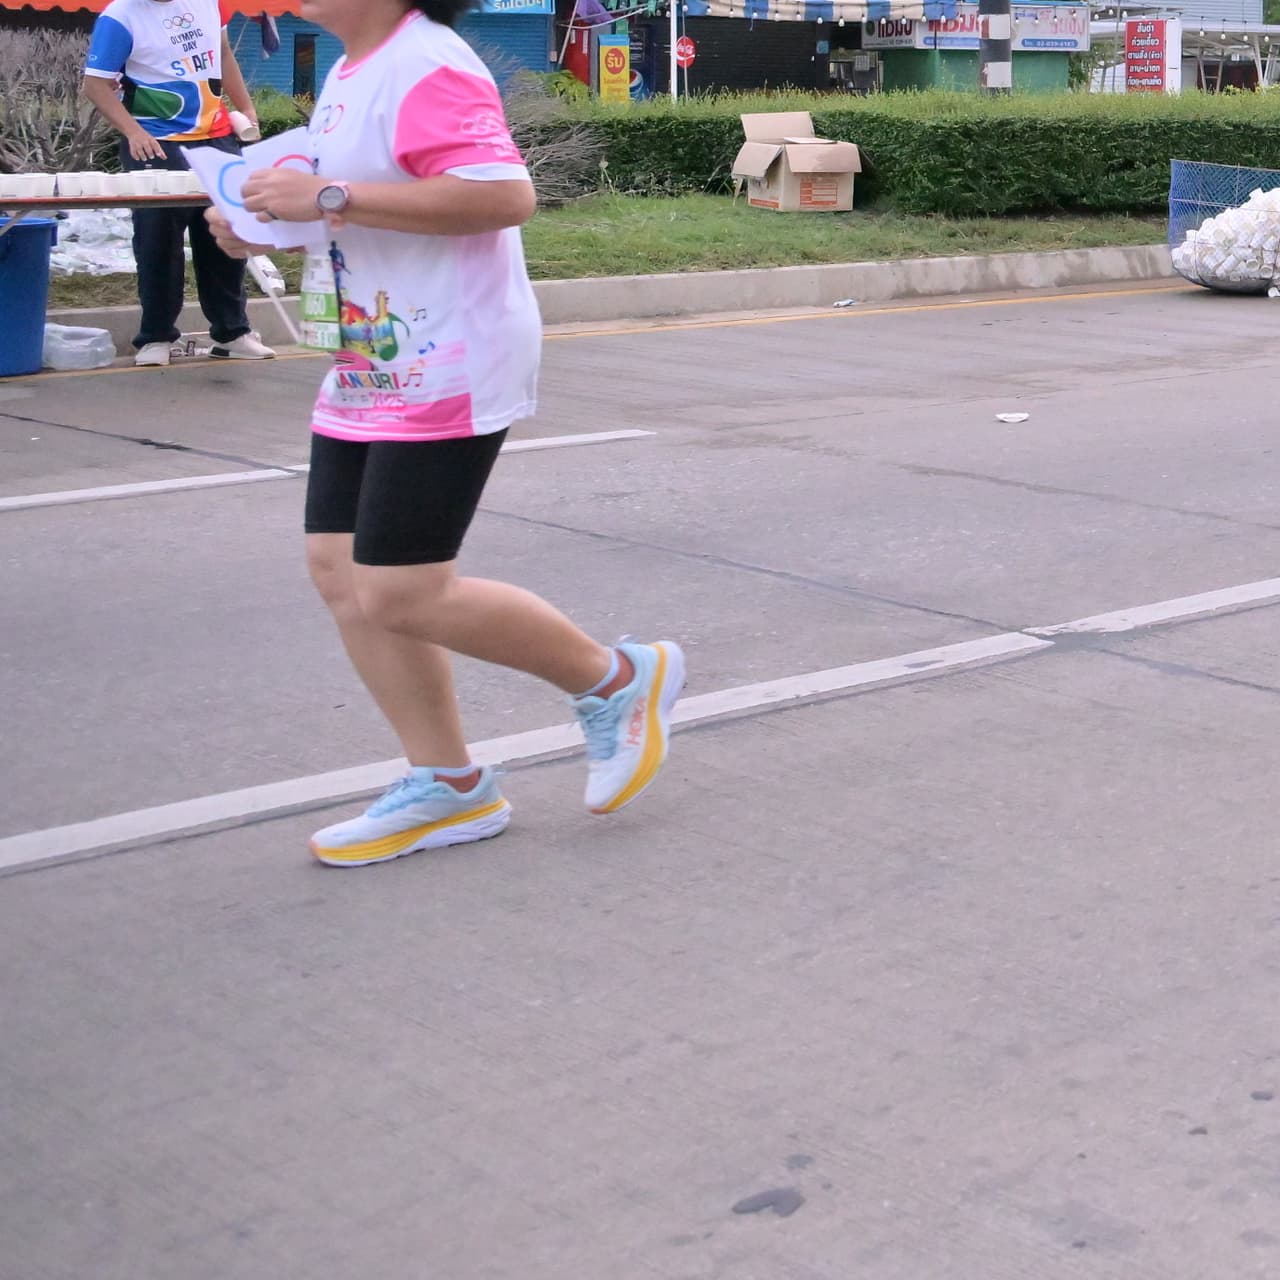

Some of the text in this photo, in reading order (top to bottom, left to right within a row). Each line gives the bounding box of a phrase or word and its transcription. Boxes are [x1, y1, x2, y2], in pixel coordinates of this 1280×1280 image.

[170, 28, 203, 45] OLYMPIC
[182, 40, 198, 52] DAY
[170, 50, 214, 76] STAFF
[607, 53, 623, 68] รับ
